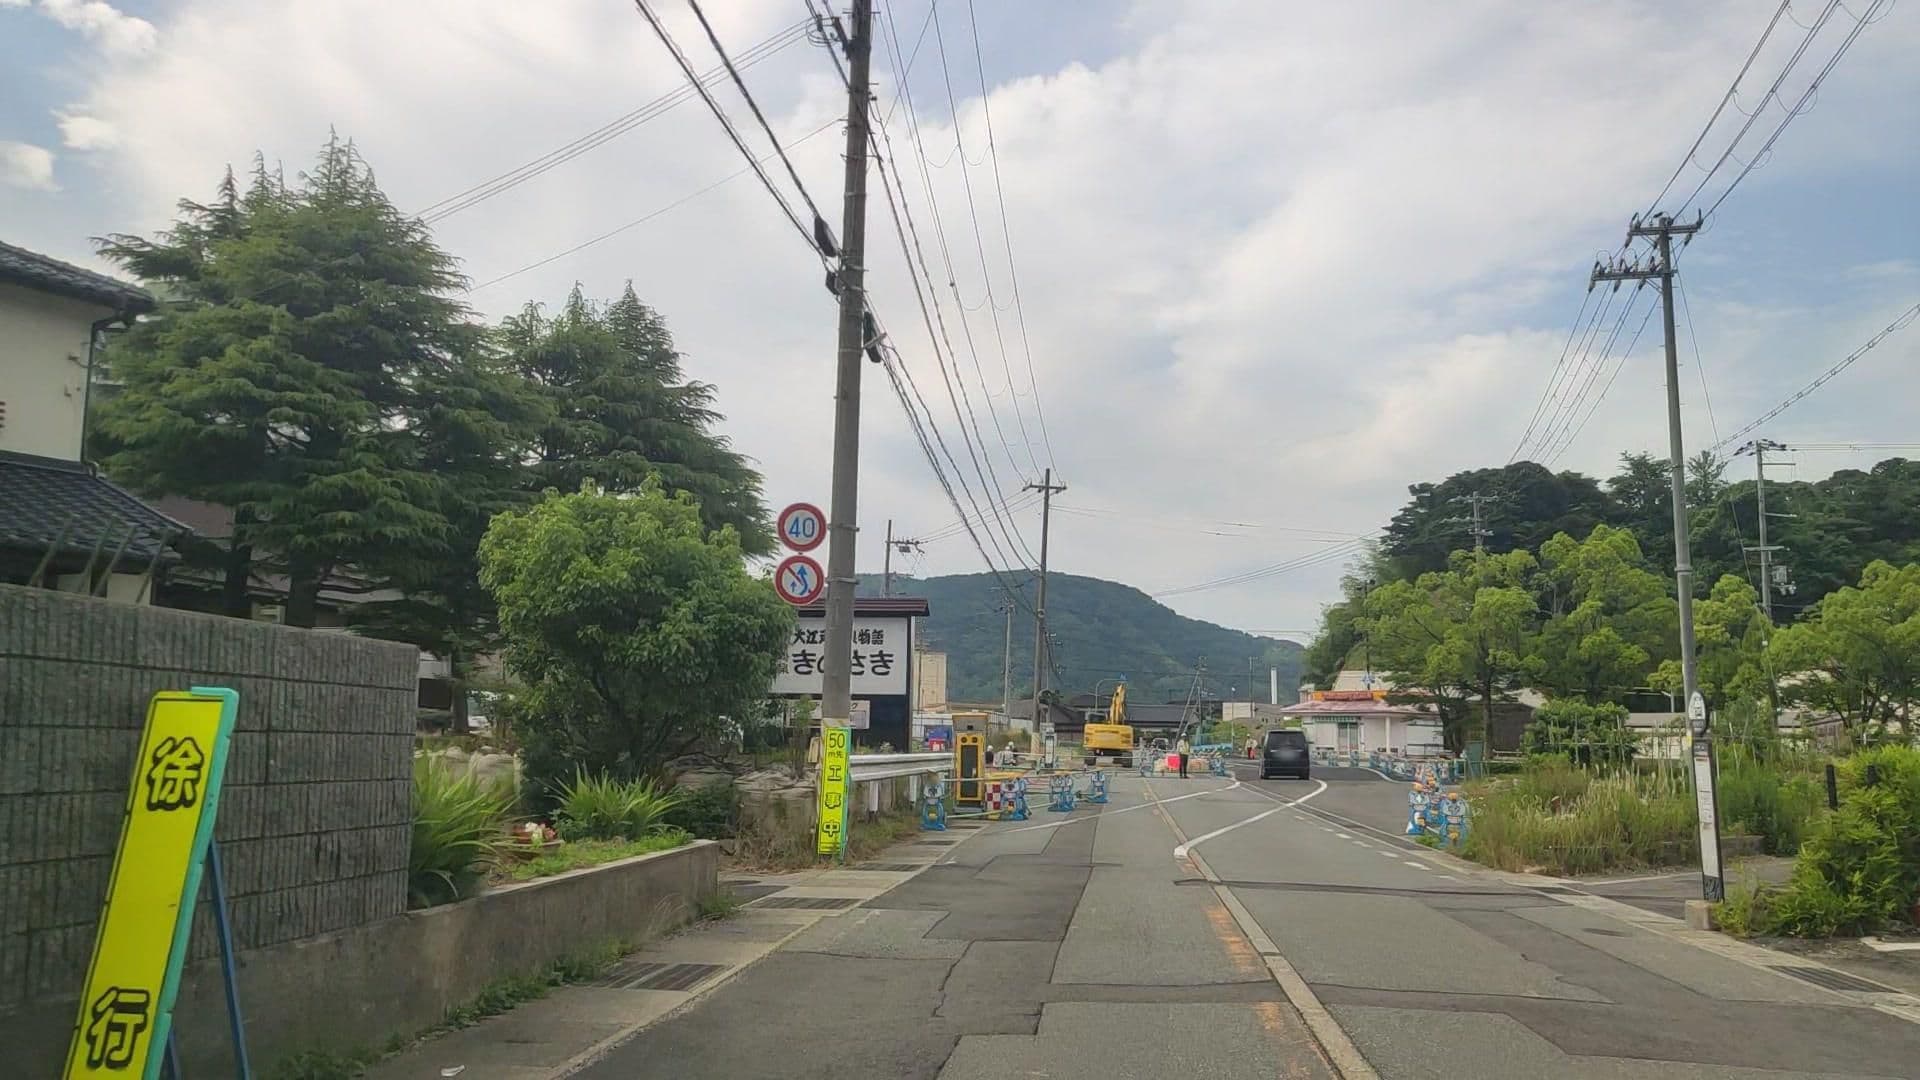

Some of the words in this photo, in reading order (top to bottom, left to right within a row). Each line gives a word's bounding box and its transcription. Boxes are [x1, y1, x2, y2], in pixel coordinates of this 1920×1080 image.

[789, 517, 815, 538] 40
[793, 649, 894, 676] きさき
[829, 733, 845, 749] 50
[822, 765, 841, 838] 工事中
[86, 737, 204, 1069] 徐行
